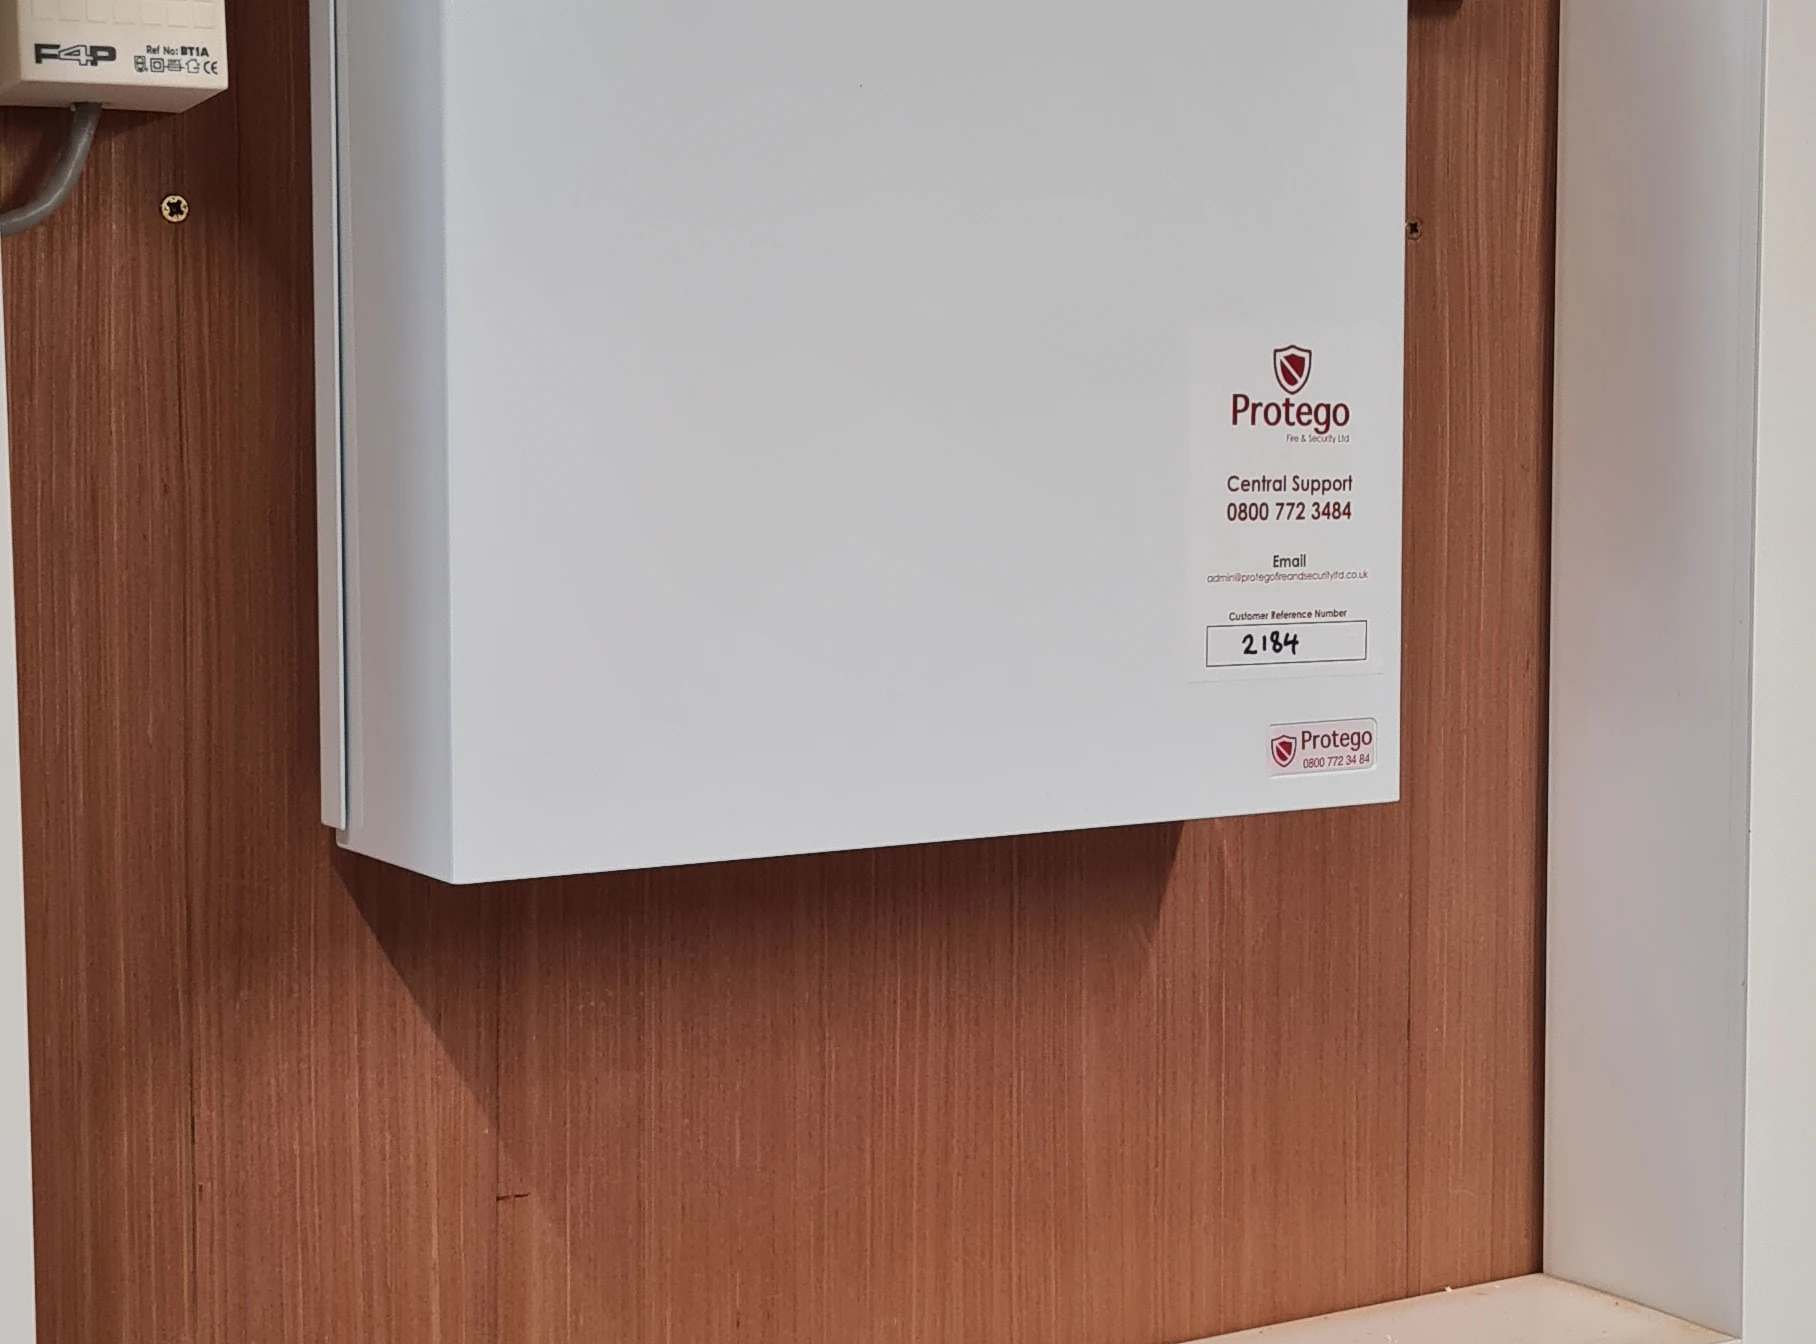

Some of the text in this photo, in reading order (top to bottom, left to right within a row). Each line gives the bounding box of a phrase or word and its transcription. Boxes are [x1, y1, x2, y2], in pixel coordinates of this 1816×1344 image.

[34, 43, 117, 67] F4P
[146, 44, 210, 58] Ref No: BT1A
[1231, 393, 1350, 435] Protego
[1286, 434, 1350, 444] Fire & Security Ltd
[1227, 474, 1353, 495] Central Support
[1226, 501, 1353, 522] 0800 772 3484
[1273, 554, 1307, 568] Email
[1229, 608, 1348, 621] Customer Reference Number
[1242, 630, 1299, 655] 2184
[1301, 730, 1373, 751] Protego
[1303, 754, 1370, 769] 0800 772 34 84
